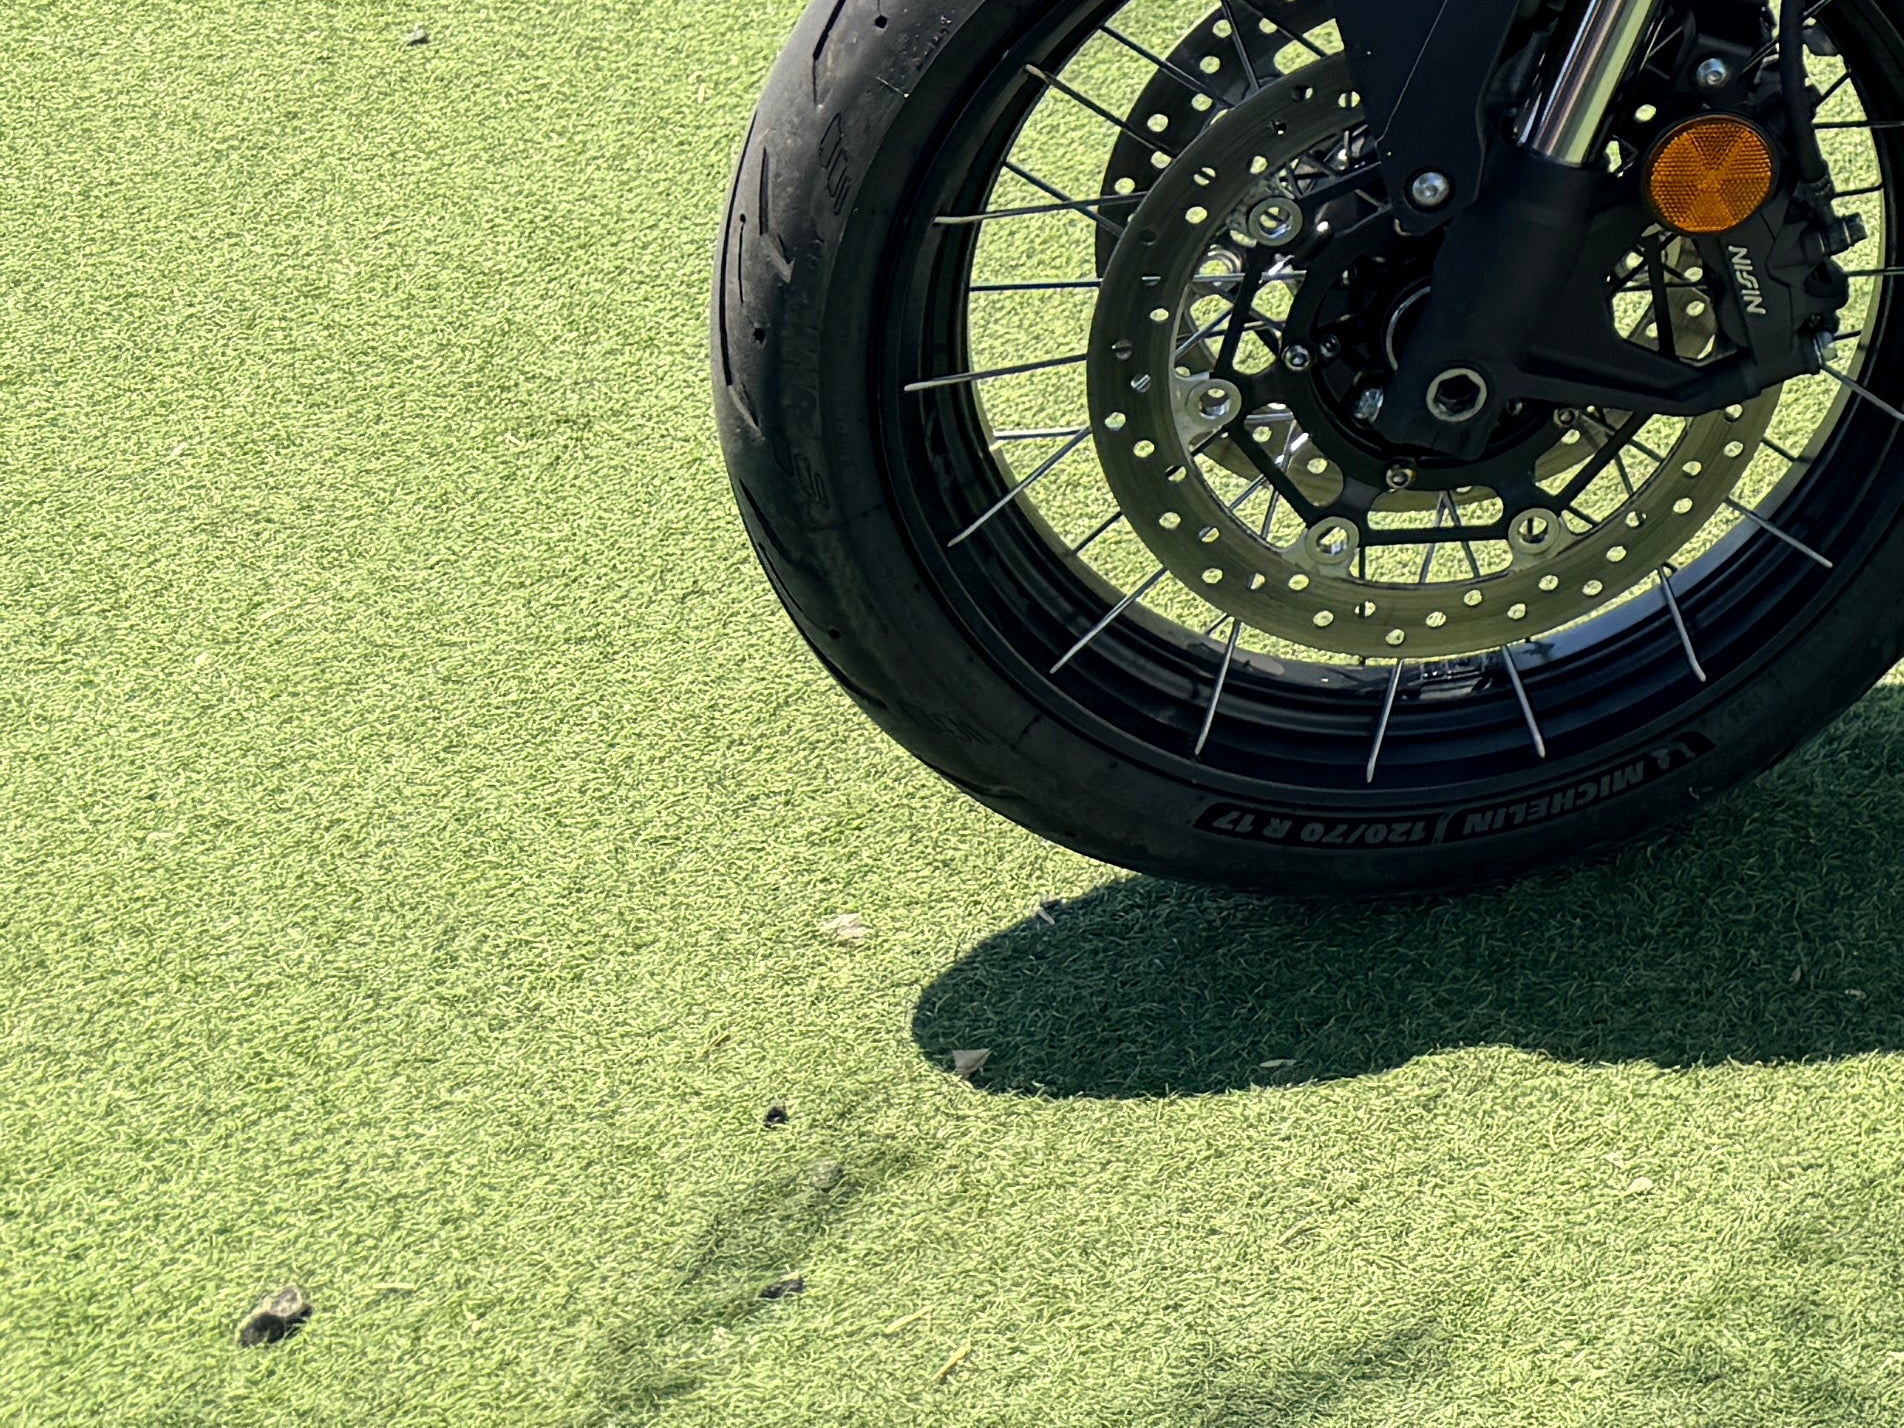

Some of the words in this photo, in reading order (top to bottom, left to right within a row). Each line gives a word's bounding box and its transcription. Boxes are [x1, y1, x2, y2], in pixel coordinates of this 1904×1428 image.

[1460, 761, 1646, 836] MICHELIN
[1210, 809, 1258, 834] 17
[1264, 816, 1292, 840] R
[1299, 818, 1429, 846] 120/70
